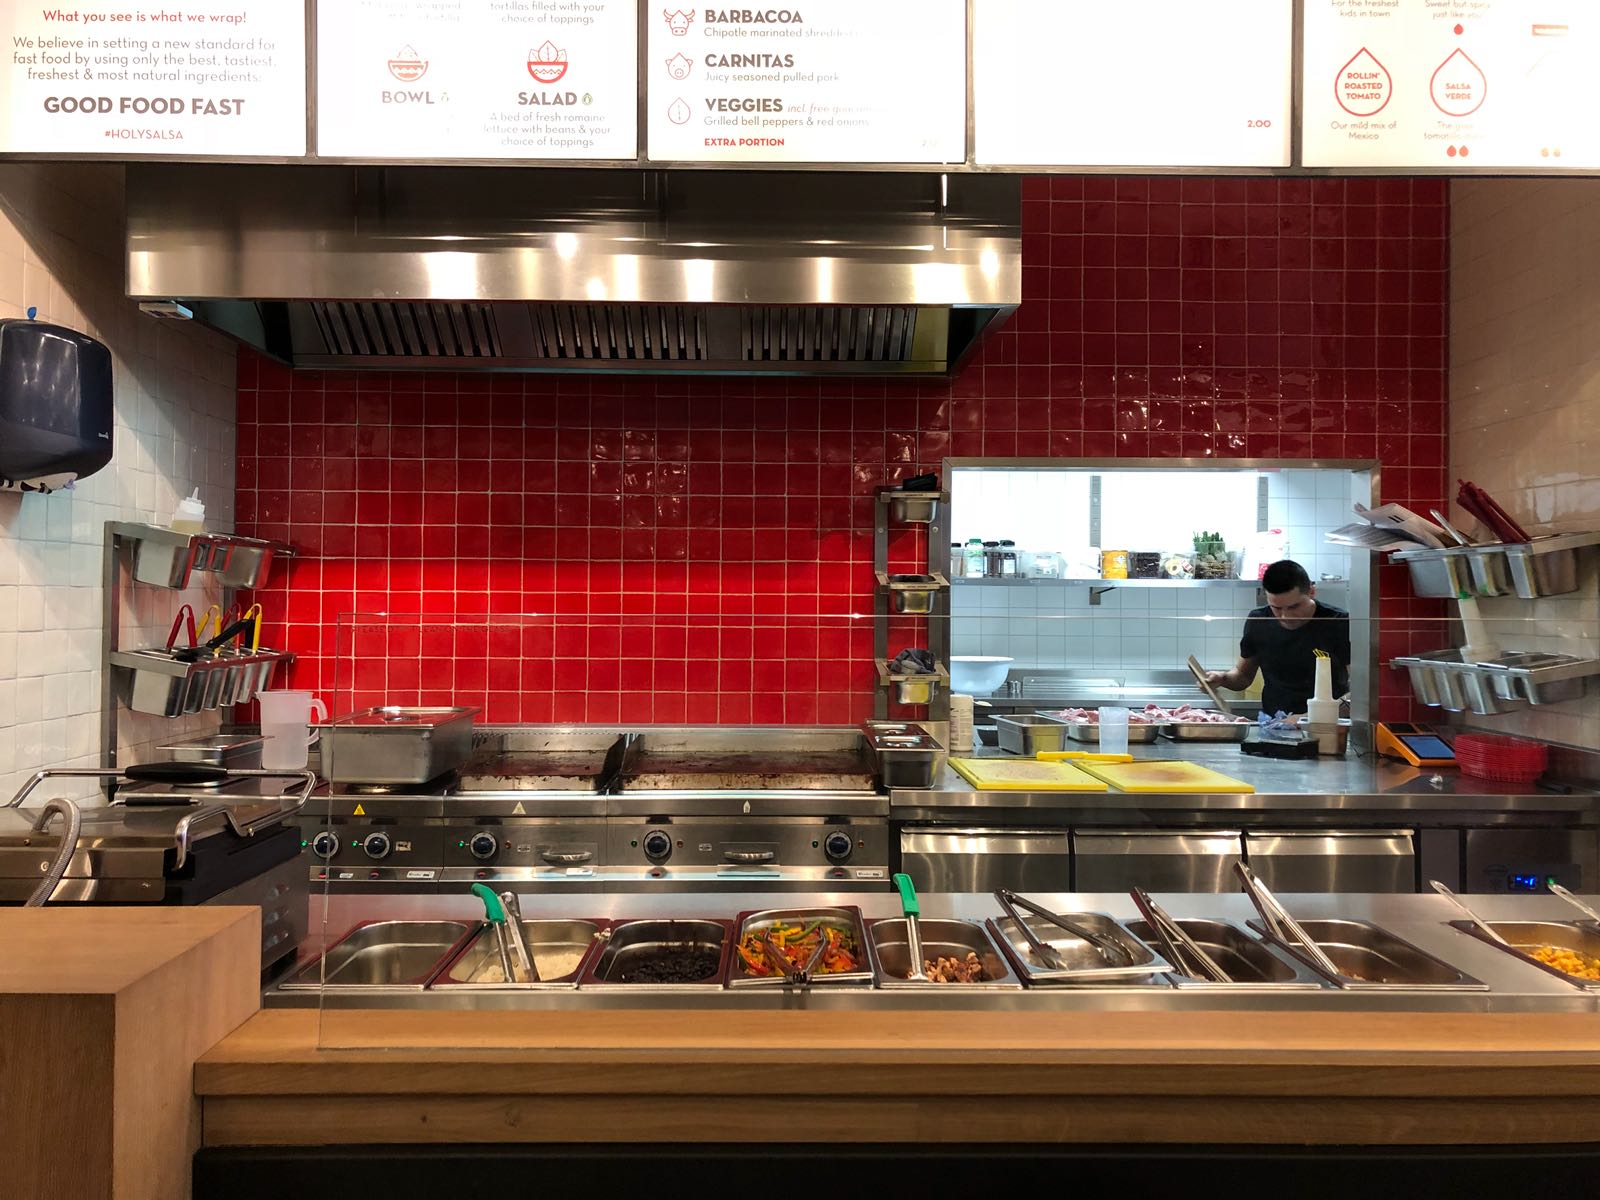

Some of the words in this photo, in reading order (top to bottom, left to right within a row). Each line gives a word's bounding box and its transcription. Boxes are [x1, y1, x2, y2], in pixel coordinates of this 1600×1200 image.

[533, 1, 556, 11] filled
[559, 3, 580, 11] with
[583, 5, 604, 13] your
[43, 10, 79, 22] What
[83, 13, 106, 24] you
[110, 13, 132, 22] see
[136, 11, 146, 22] is
[150, 12, 182, 22] what
[187, 13, 205, 23] we
[209, 12, 247, 25] wrap!
[502, 14, 534, 23] choice
[537, 13, 547, 23] of
[551, 15, 594, 25] toppings
[705, 10, 803, 23] BARBACOA
[704, 27, 747, 39] Chipotle
[750, 28, 802, 37] marinated
[13, 36, 33, 48] We
[38, 36, 83, 49] believe
[88, 37, 99, 49] in
[103, 38, 147, 51] setting
[152, 40, 160, 49] a
[164, 40, 190, 49] new
[195, 38, 254, 50] standard
[258, 38, 275, 50] for
[13, 52, 37, 64] fast
[41, 52, 70, 65] food
[75, 53, 90, 66] by
[94, 54, 128, 67] using
[132, 53, 160, 67] only
[164, 53, 185, 65] the
[705, 54, 794, 68] CARNITAS
[28, 67, 79, 80] freshest
[83, 69, 93, 80] &
[98, 70, 128, 81] most
[133, 69, 180, 81] natural
[705, 72, 730, 83] Juicy
[732, 72, 780, 82] seasoned
[783, 72, 814, 83] pulled
[817, 72, 839, 83] pork
[382, 91, 435, 104] BOWL
[517, 92, 577, 106] SALAD
[44, 96, 113, 114] GOOD
[120, 97, 185, 114] FOOD
[192, 98, 246, 115] FAST
[705, 99, 783, 112] VEGGIES
[787, 103, 806, 113] incl.
[809, 101, 830, 115] free
[501, 112, 519, 121] bed
[523, 112, 533, 121] of
[536, 112, 561, 121] fresh
[704, 116, 739, 126] Grilled
[741, 116, 760, 126] bell
[762, 117, 803, 129] peppers
[807, 117, 814, 126] &
[816, 117, 834, 126] red
[522, 125, 542, 133] with
[546, 125, 575, 134] beans
[579, 125, 586, 133] &
[589, 127, 610, 135] your
[1331, 121, 1347, 129] Our
[1350, 121, 1368, 129] mild
[1388, 121, 1397, 129] of
[105, 129, 183, 140] #HOLYSALSA
[1349, 132, 1379, 140] Mexico
[502, 137, 534, 146] choice
[537, 136, 547, 145] of
[550, 137, 594, 148] toppings
[705, 138, 736, 147] EXTRA
[739, 138, 784, 147] PORTION
